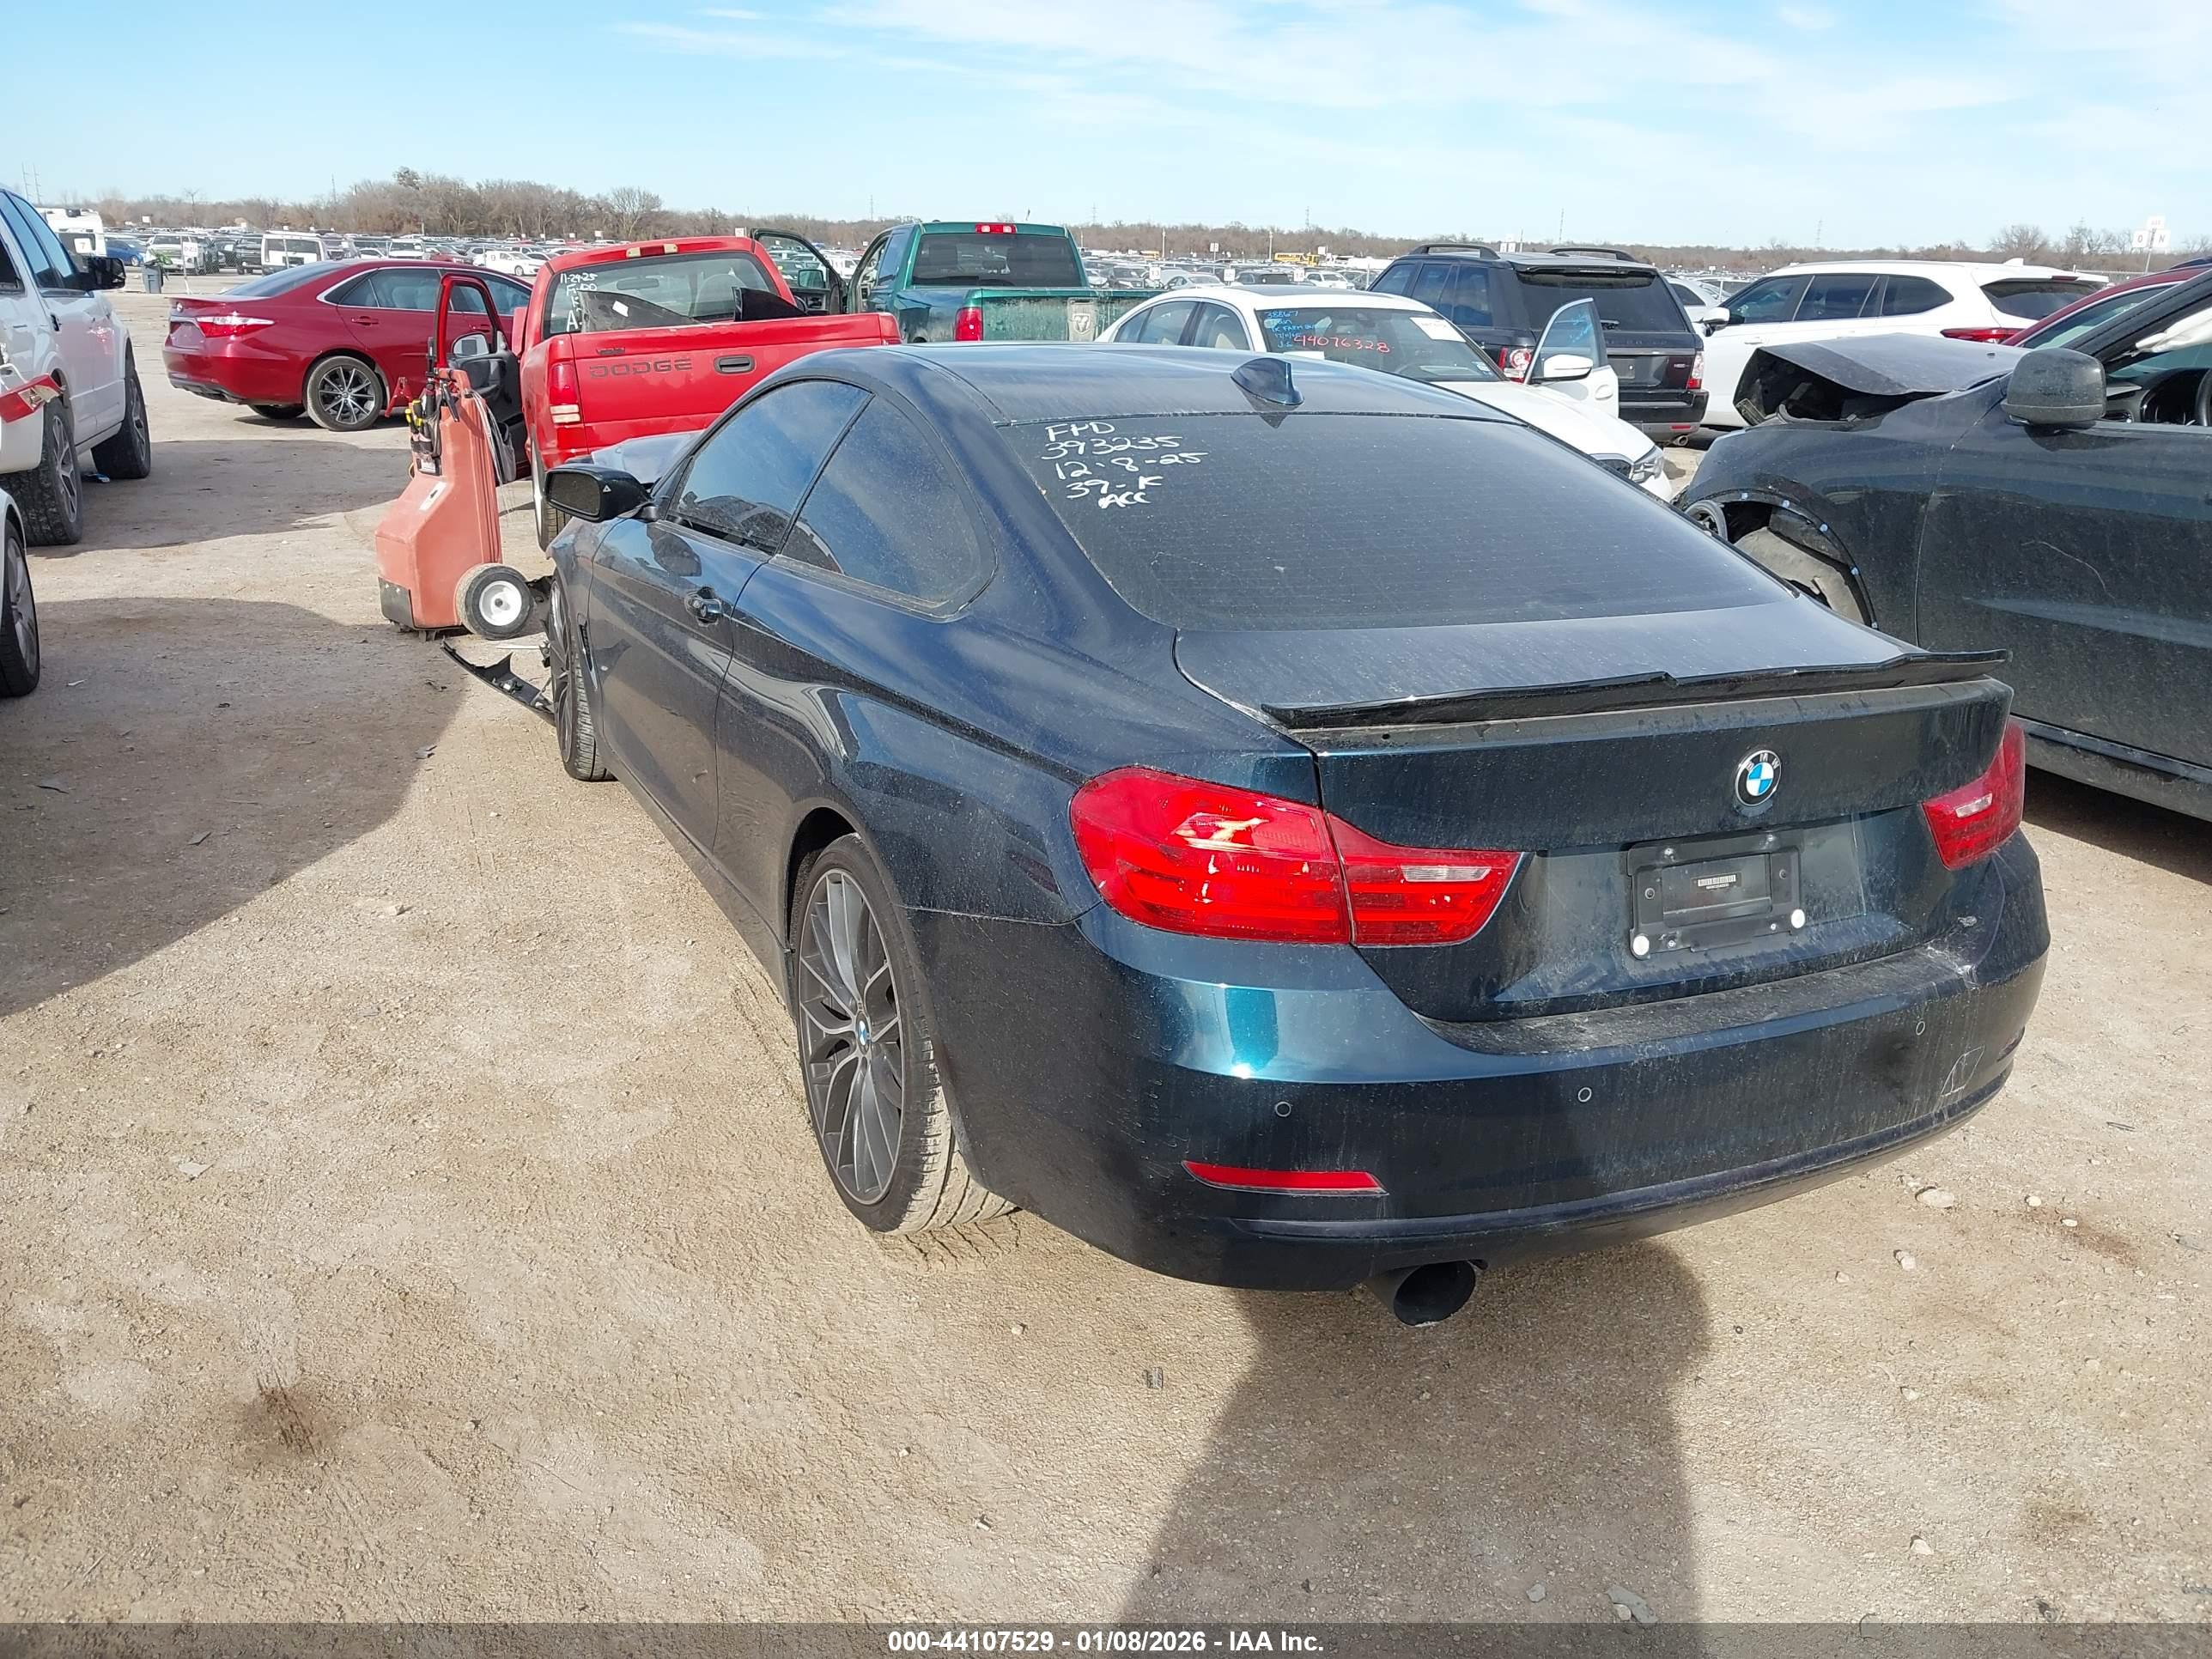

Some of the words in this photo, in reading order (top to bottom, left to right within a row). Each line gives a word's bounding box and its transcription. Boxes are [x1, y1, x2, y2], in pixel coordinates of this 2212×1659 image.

[1293, 335, 1391, 354] 44076328
[589, 358, 693, 378] DODGE
[1041, 436, 1183, 459] 393235
